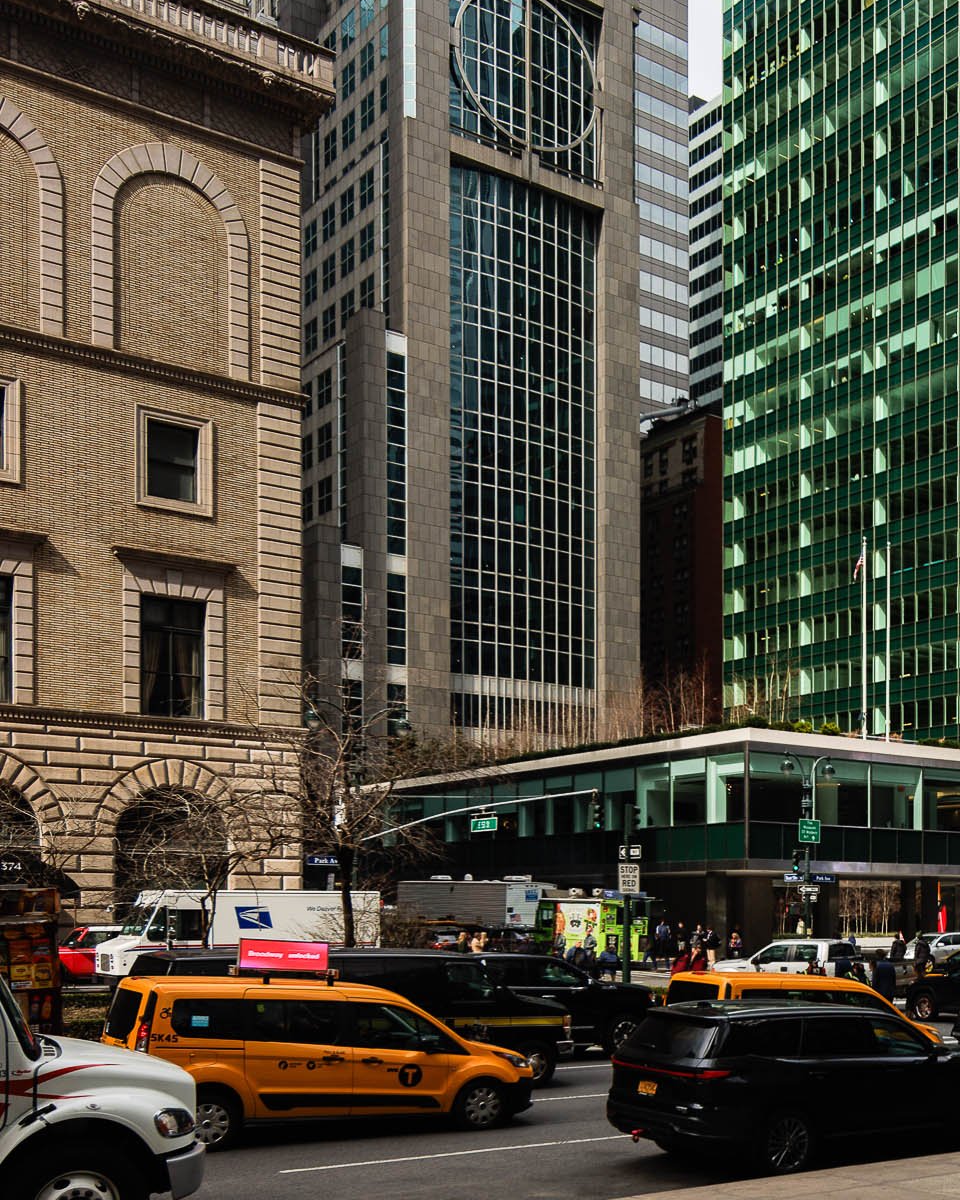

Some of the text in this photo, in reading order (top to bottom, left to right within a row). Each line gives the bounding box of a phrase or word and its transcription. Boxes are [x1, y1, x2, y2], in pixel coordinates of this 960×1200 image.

[1, 862, 22, 870] 374
[620, 866, 638, 874] STOP
[405, 1069, 416, 1084] T
